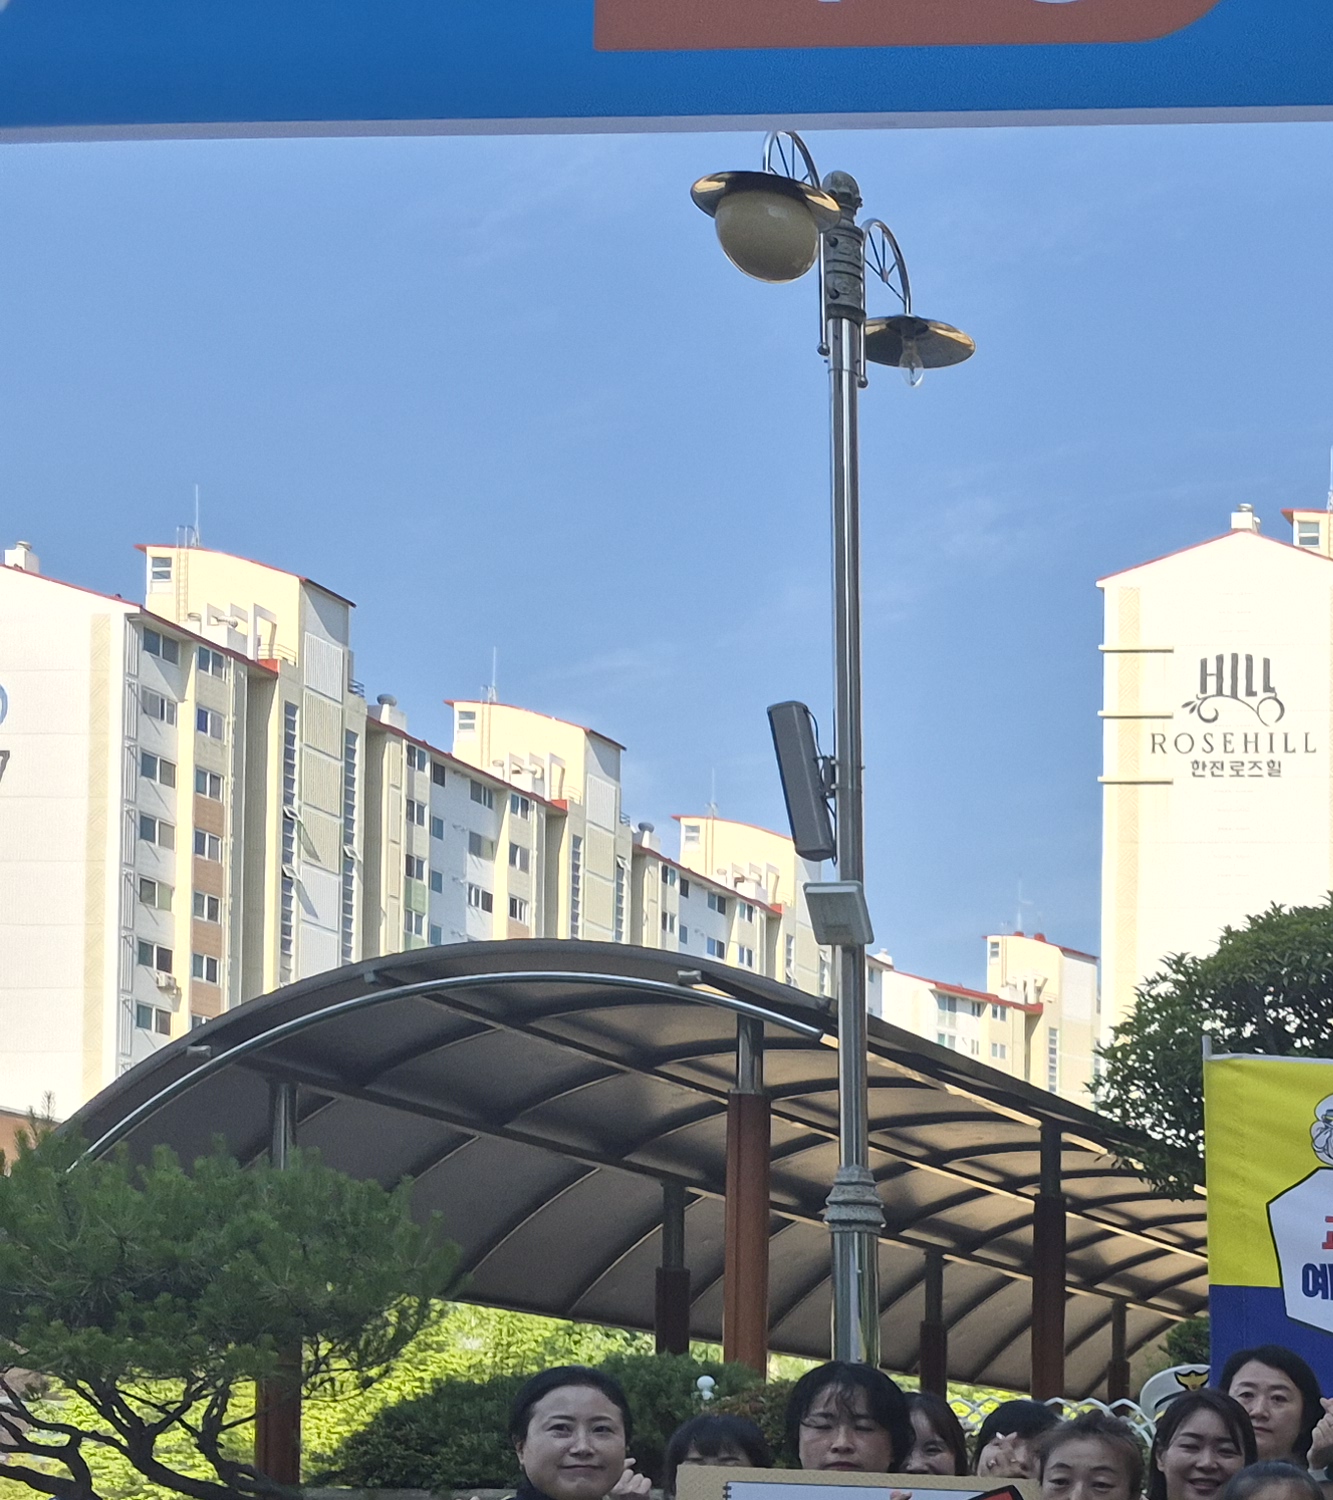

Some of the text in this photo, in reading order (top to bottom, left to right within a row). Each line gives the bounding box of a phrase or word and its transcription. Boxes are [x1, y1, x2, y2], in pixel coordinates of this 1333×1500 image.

[1200, 653, 1276, 697] HILL
[1150, 732, 1317, 754] ROSEHILL
[1191, 760, 1282, 778] 한진로즈힐
